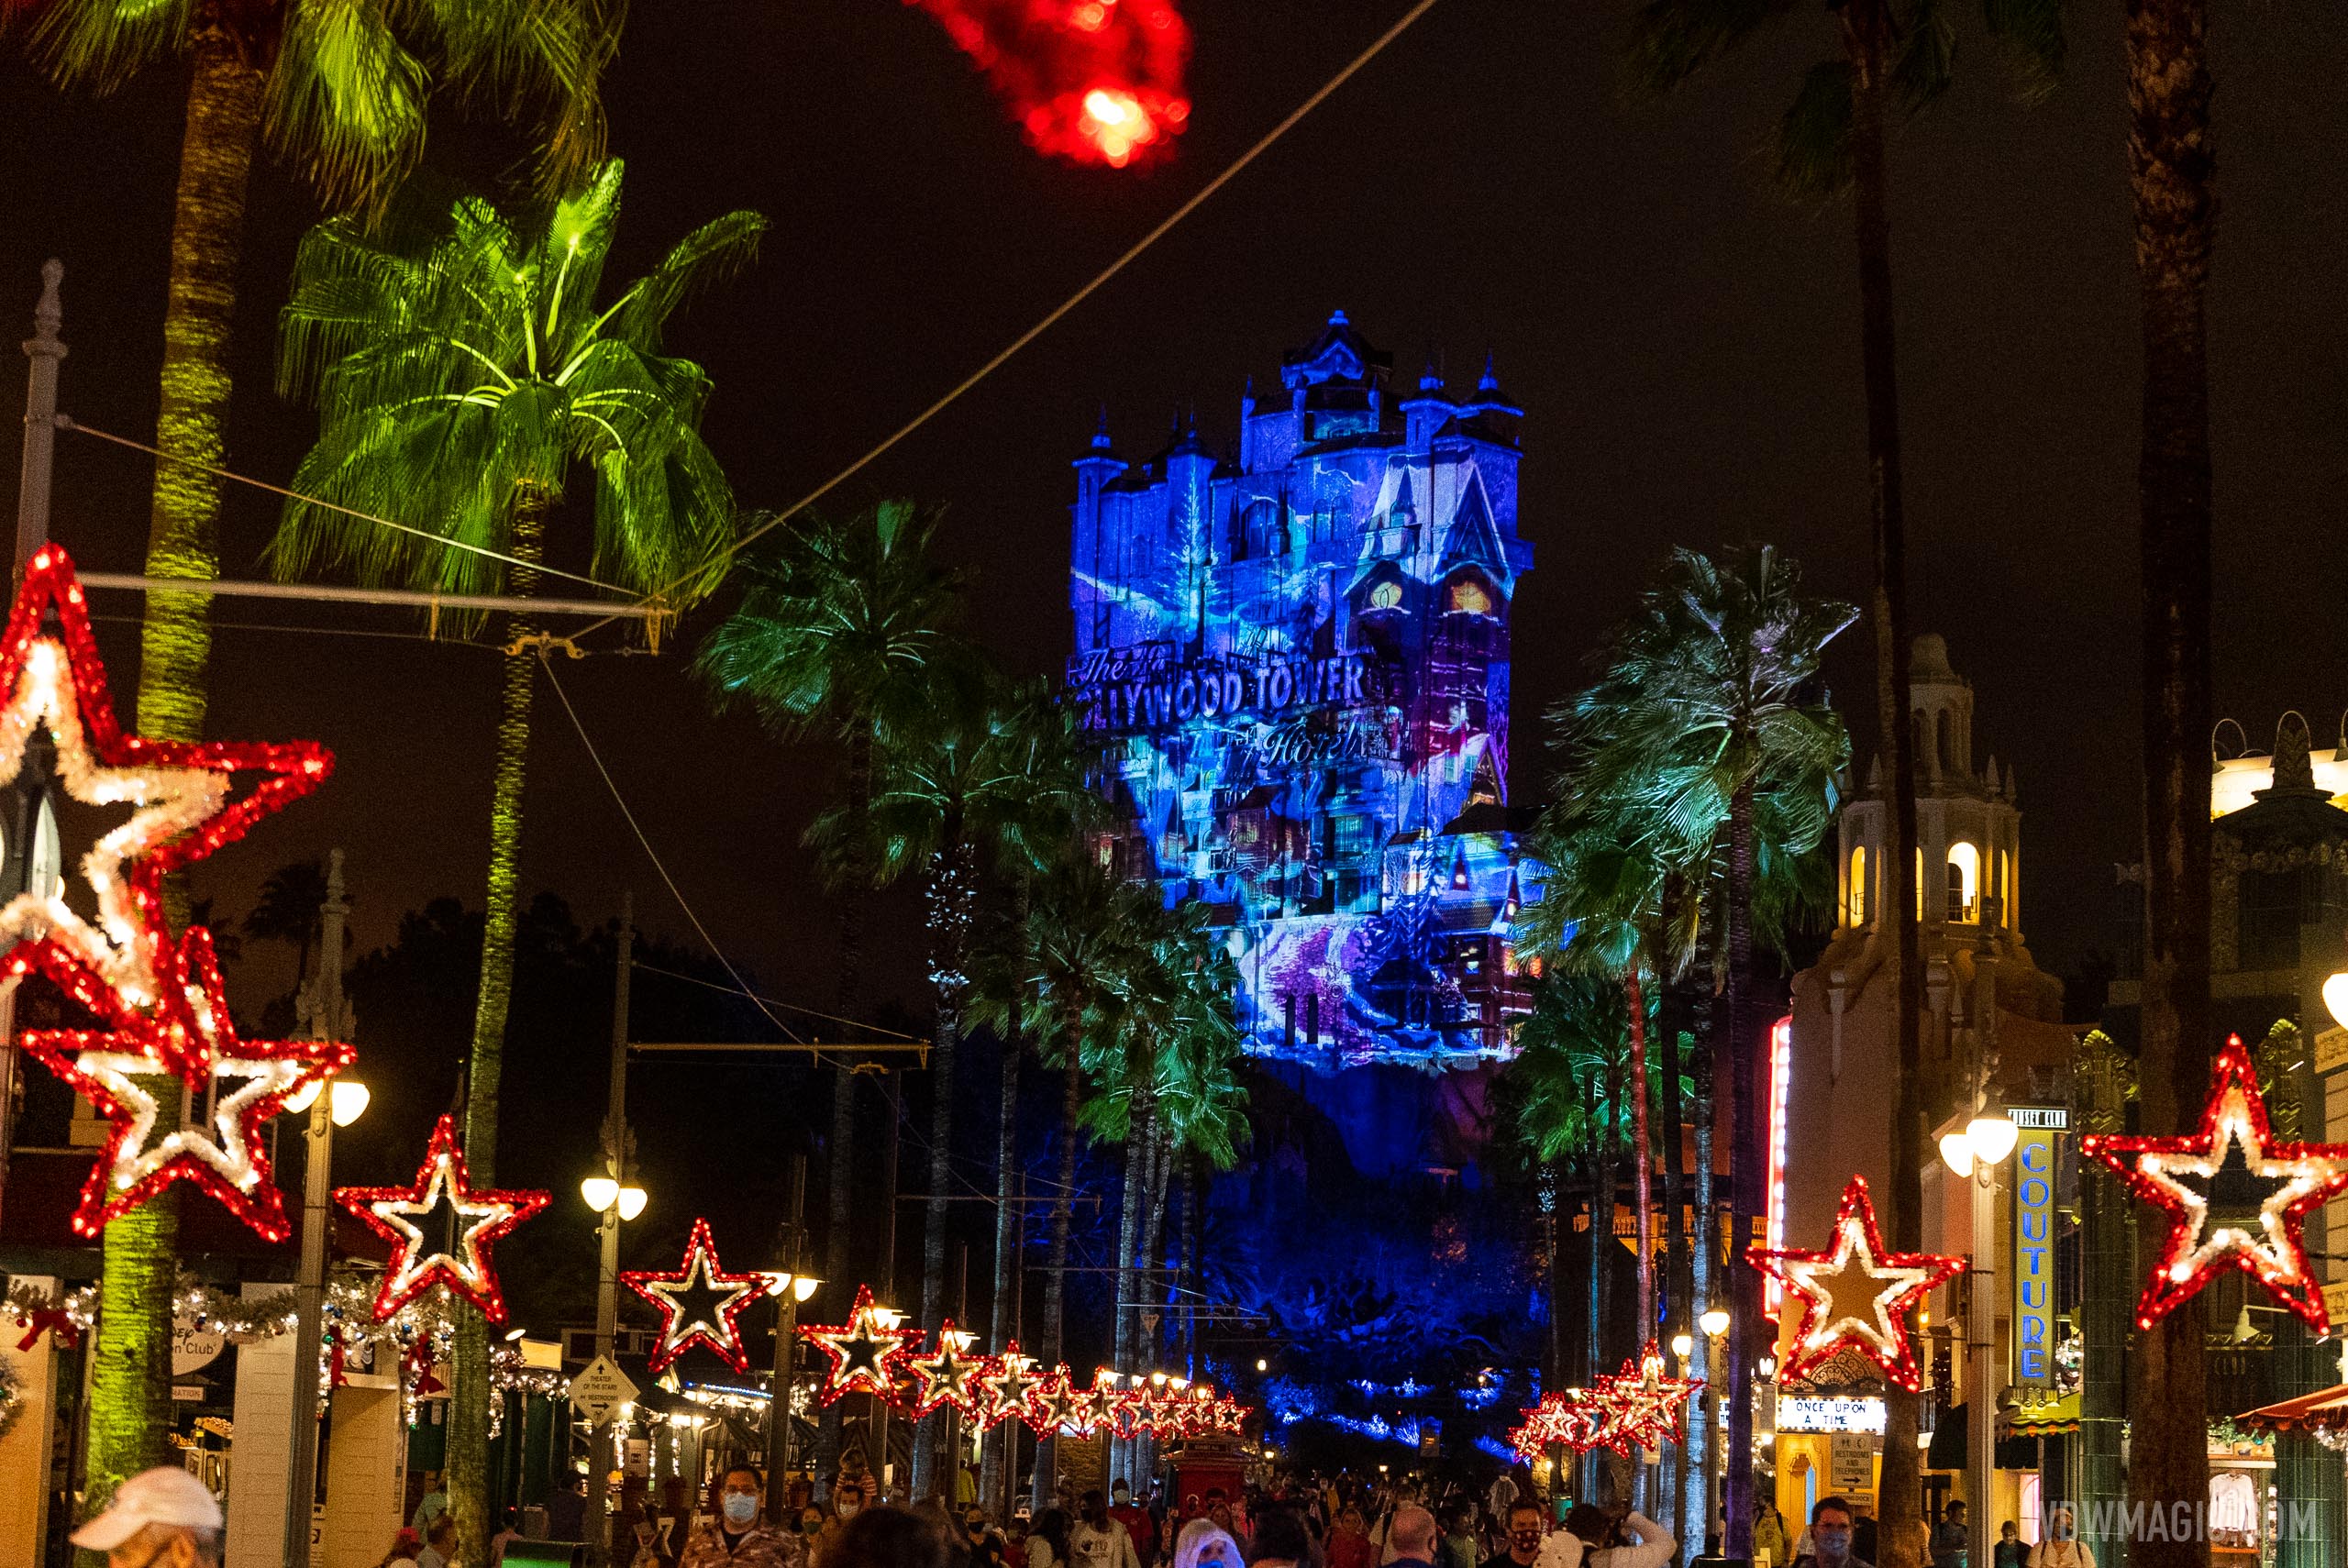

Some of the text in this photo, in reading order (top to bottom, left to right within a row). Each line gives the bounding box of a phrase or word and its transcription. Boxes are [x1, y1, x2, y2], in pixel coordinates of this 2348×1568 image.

[1069, 647, 1127, 687] The
[1256, 657, 1365, 710] TOWER
[1257, 714, 1365, 768] Hotel
[2020, 1143, 2050, 1379] COUTURE
[186, 1342, 215, 1355] Club
[1796, 1402, 1866, 1414] ONCE UPON
[1804, 1415, 1847, 1425] A TIME
